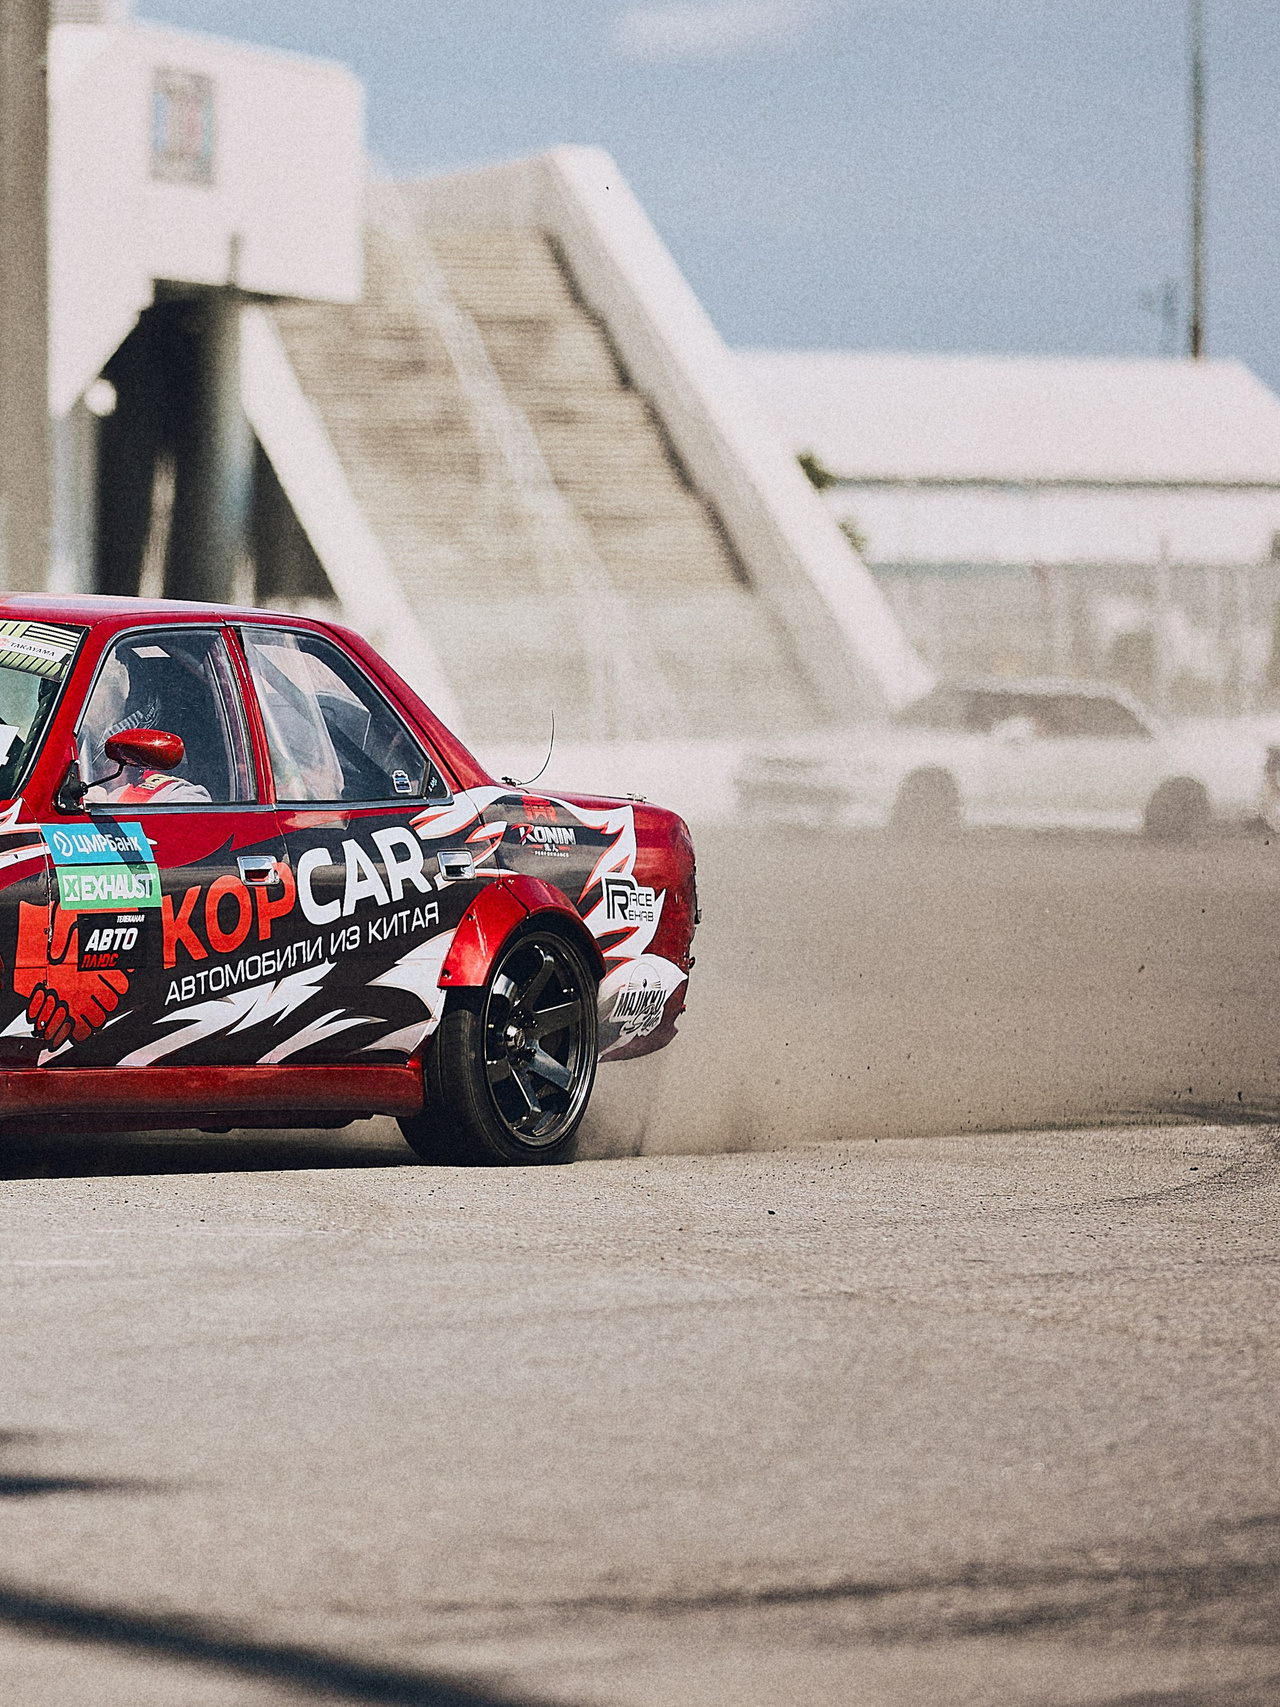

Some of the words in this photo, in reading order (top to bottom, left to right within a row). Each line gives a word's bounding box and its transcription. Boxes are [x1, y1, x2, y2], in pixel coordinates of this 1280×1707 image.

[10, 642, 55, 657] TAKAYAMA
[72, 833, 143, 854] ЦМРБанк
[511, 823, 577, 846] RONIN
[81, 873, 157, 901] EXHAUST
[84, 927, 138, 952] АВТО
[81, 953, 119, 968] ПЛЮС
[164, 936, 323, 1006] АВТОМОБИЛИ
[330, 925, 361, 955] ИЗ
[368, 901, 440, 944] КИТАЯ
